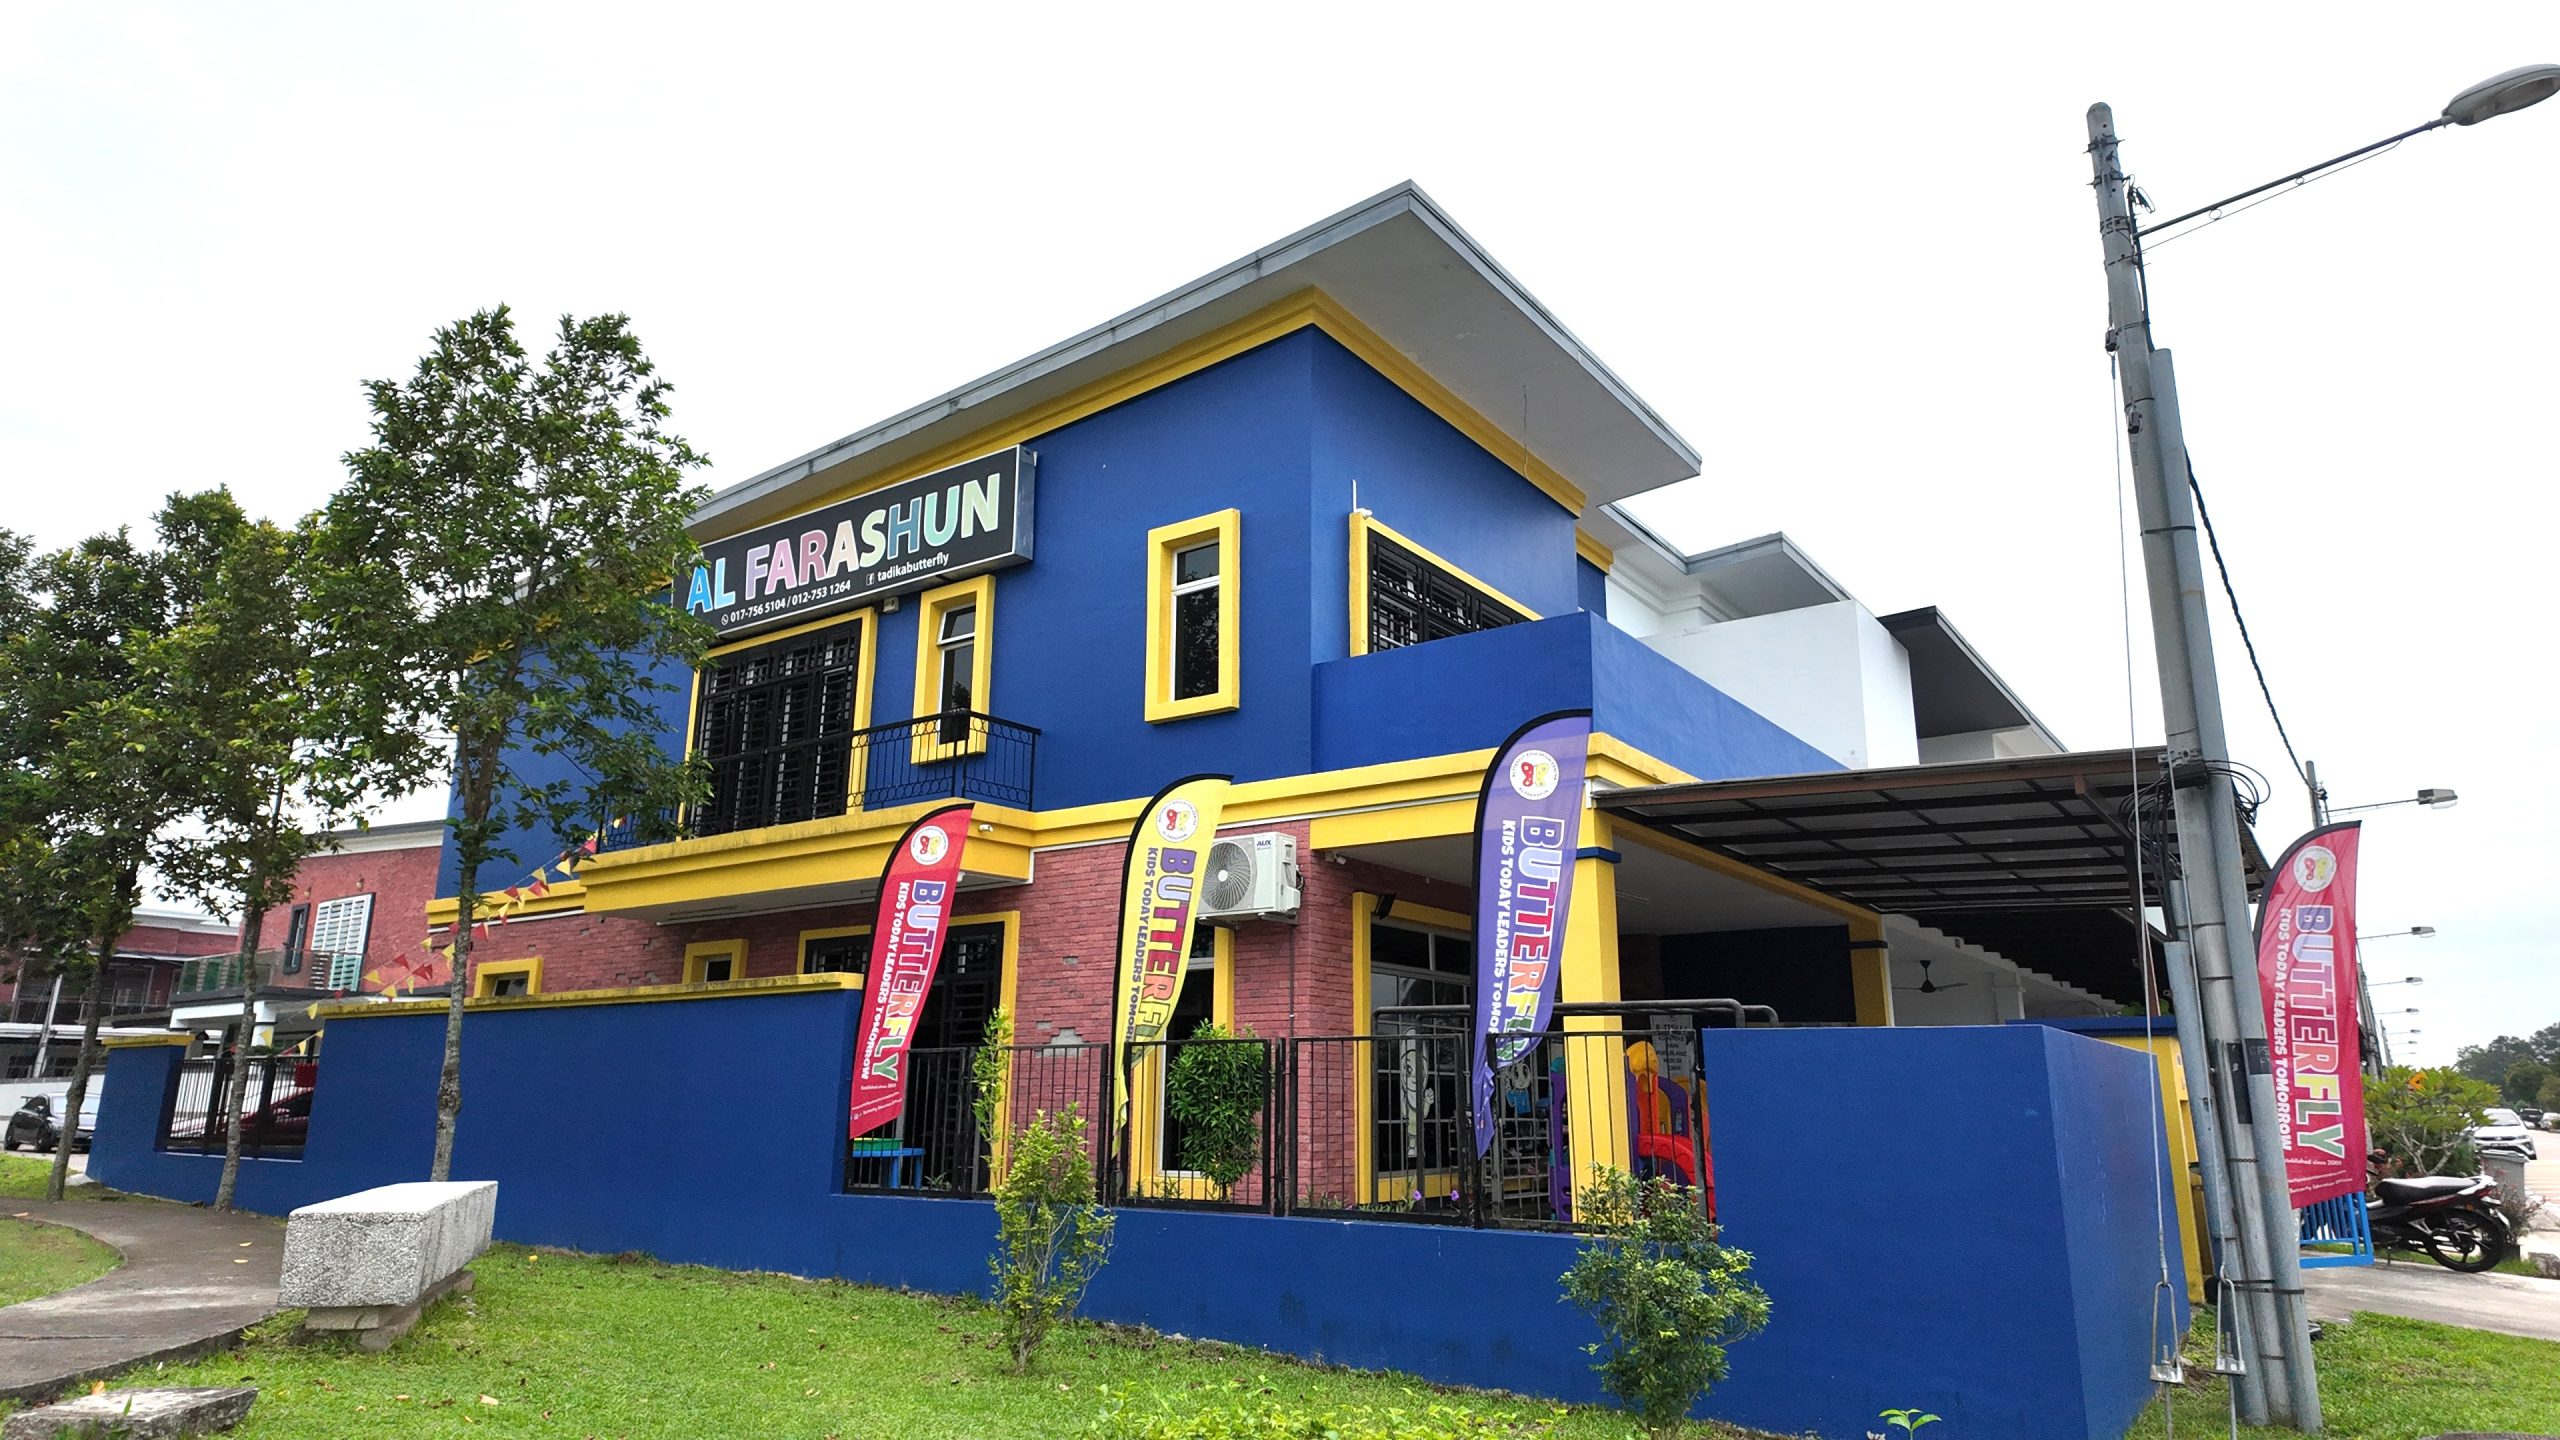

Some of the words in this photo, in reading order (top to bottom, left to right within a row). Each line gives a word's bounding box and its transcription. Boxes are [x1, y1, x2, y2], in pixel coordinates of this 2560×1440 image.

[686, 557, 736, 616] AL
[745, 473, 1001, 601] FARASHUN
[877, 551, 949, 582] tadikabutterfly
[730, 605, 763, 623] 017-756
[765, 597, 786, 613] 5104
[791, 588, 828, 606] 012-753
[830, 581, 851, 596] 1264
[1145, 847, 1158, 877] KIDS
[1501, 819, 1516, 856] KIDS
[895, 881, 910, 910] KIDS
[1139, 879, 1154, 924] TODAY
[1498, 858, 1514, 911] TODAY
[888, 911, 905, 952] TODAY
[1493, 911, 1511, 978] LEADERS
[2278, 908, 2292, 941] KIDS
[872, 879, 946, 1082] BUTTERFLY
[877, 952, 896, 1004] LEADERS
[1131, 847, 1197, 1063] BUTTERFL
[1132, 925, 1148, 983] LEADERS
[2274, 942, 2290, 991] TODAY
[1126, 985, 1140, 1042] TOMOR
[1488, 980, 1504, 1034] TOMOR
[2273, 992, 2288, 1056] LEADERS
[2290, 904, 2346, 1159] BUTTERFLY
[861, 1005, 884, 1080] TOMORROW
[2275, 1057, 2292, 1151] TOMORROW
